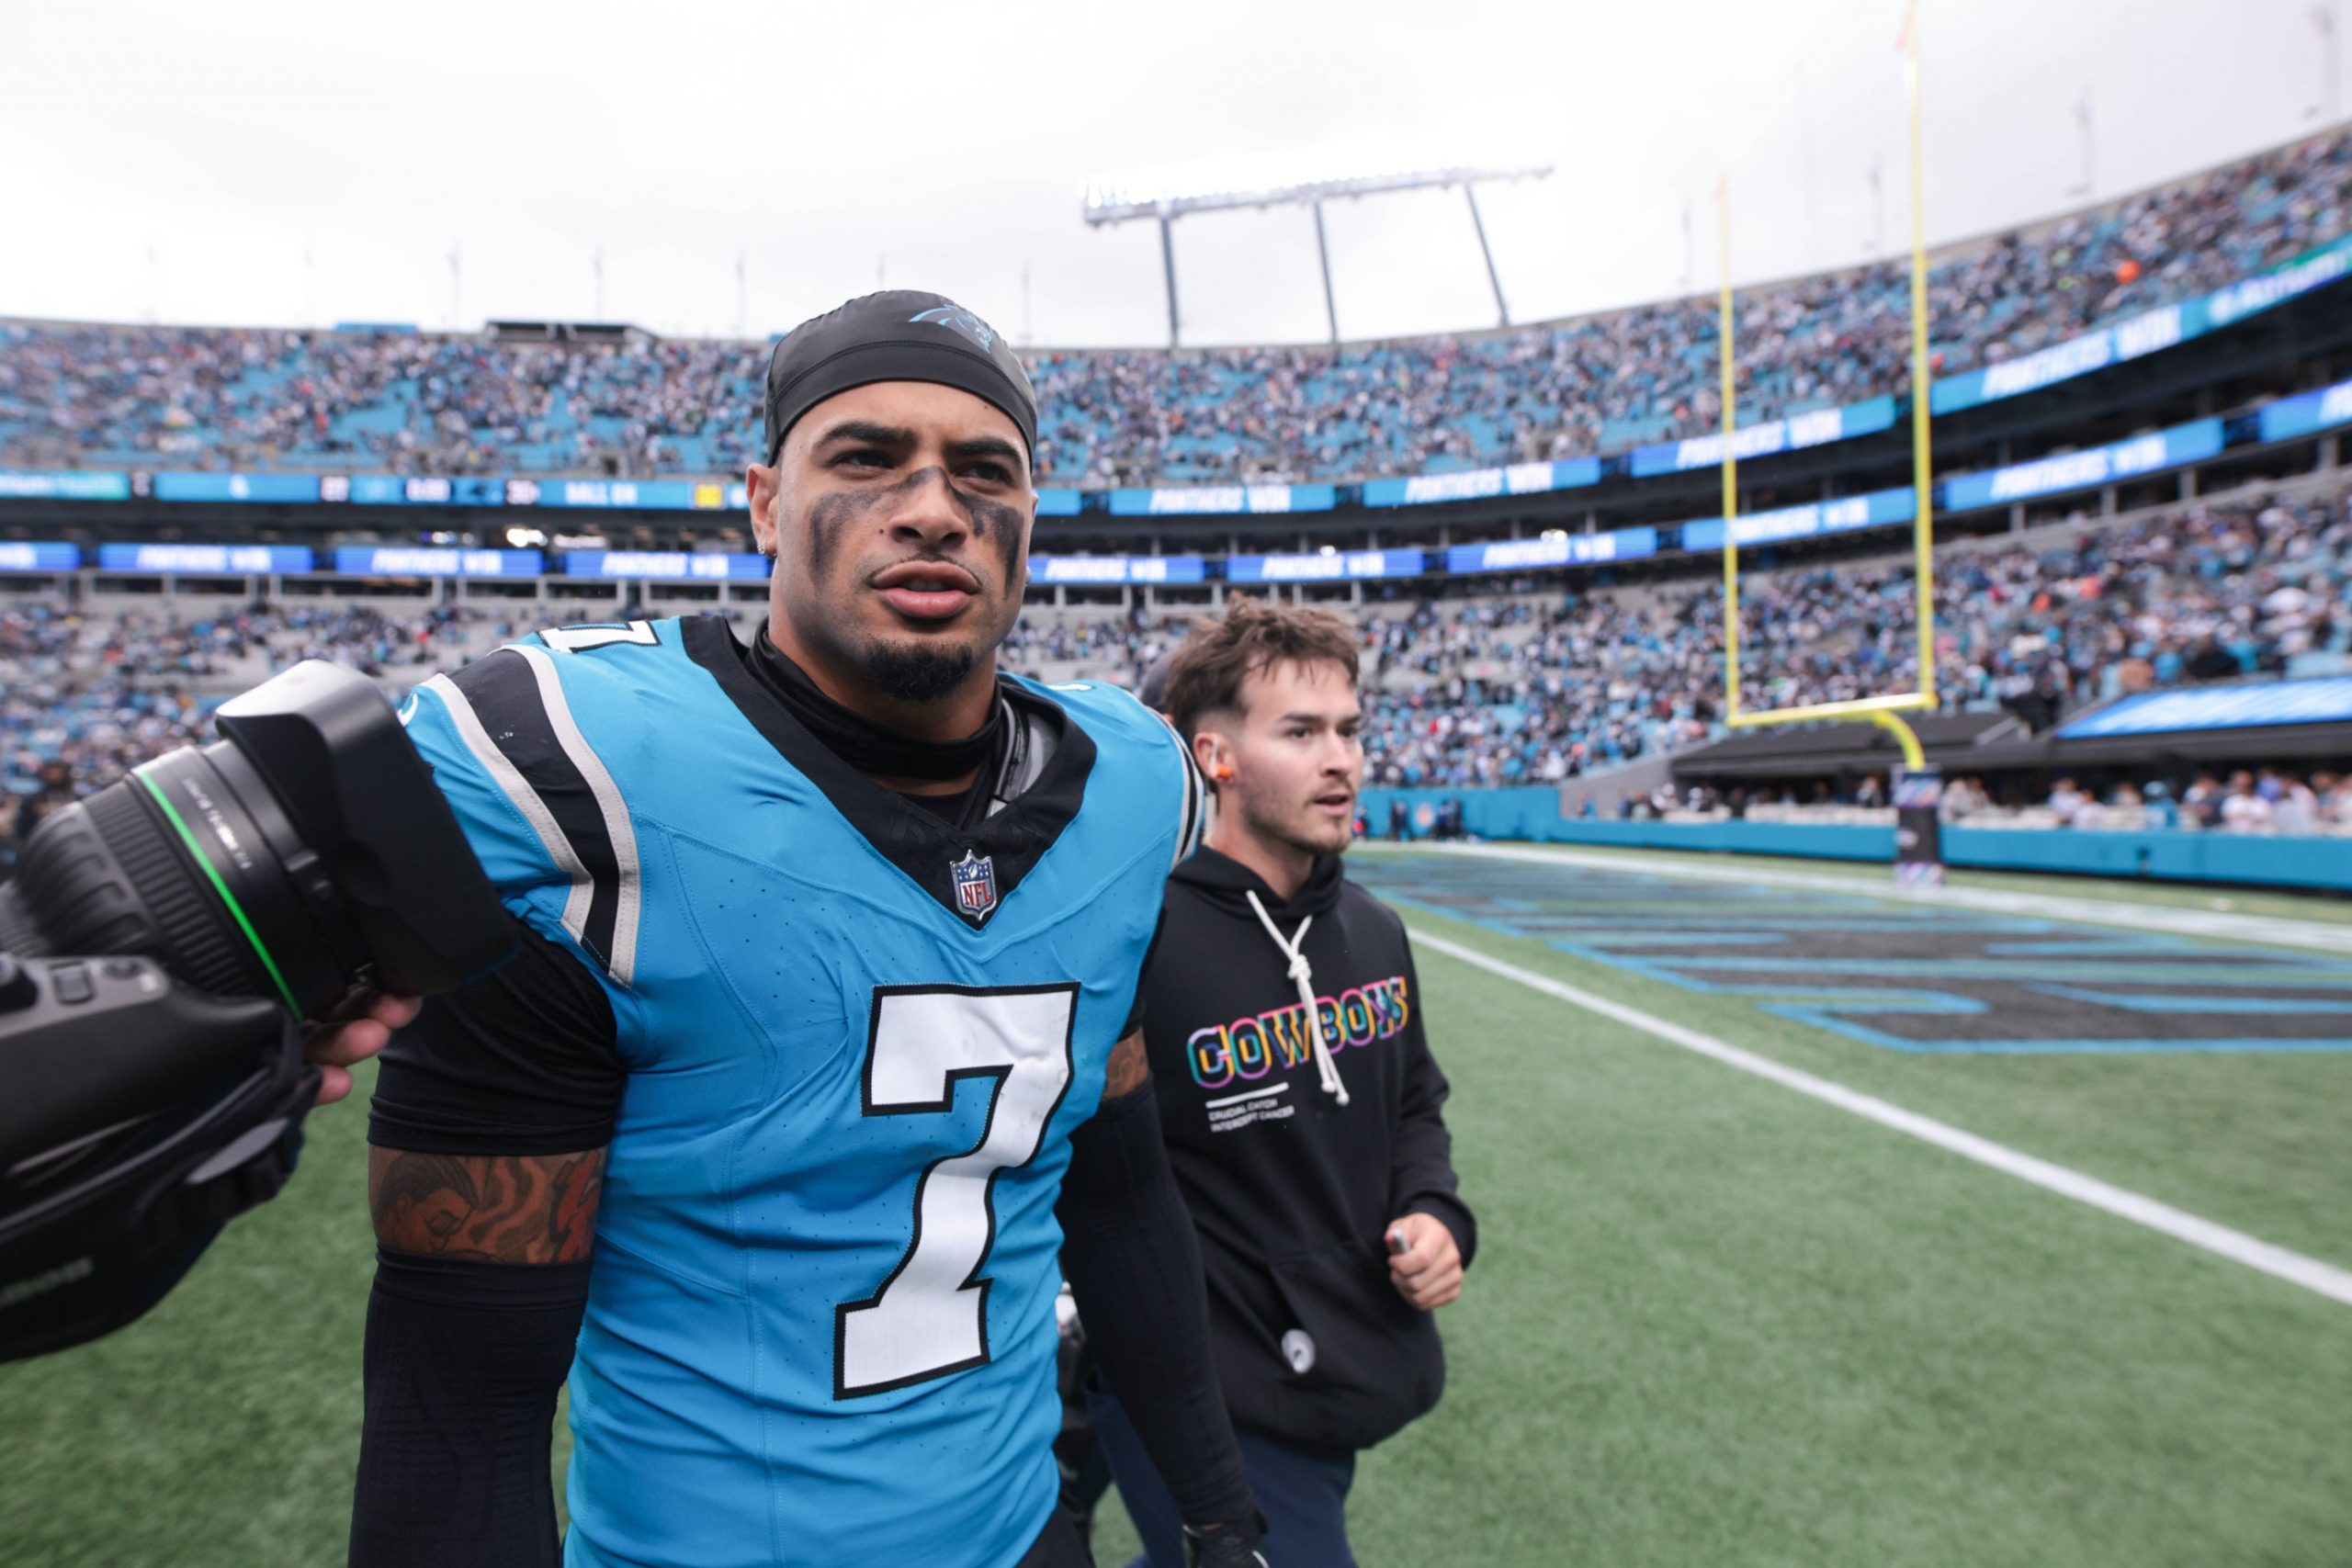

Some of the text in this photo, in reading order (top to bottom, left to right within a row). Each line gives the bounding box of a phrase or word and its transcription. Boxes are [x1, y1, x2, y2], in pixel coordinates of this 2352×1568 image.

[962, 882, 992, 907] NFL
[1186, 976, 1410, 1089] COWBOYS
[833, 981, 1081, 1400] 7
